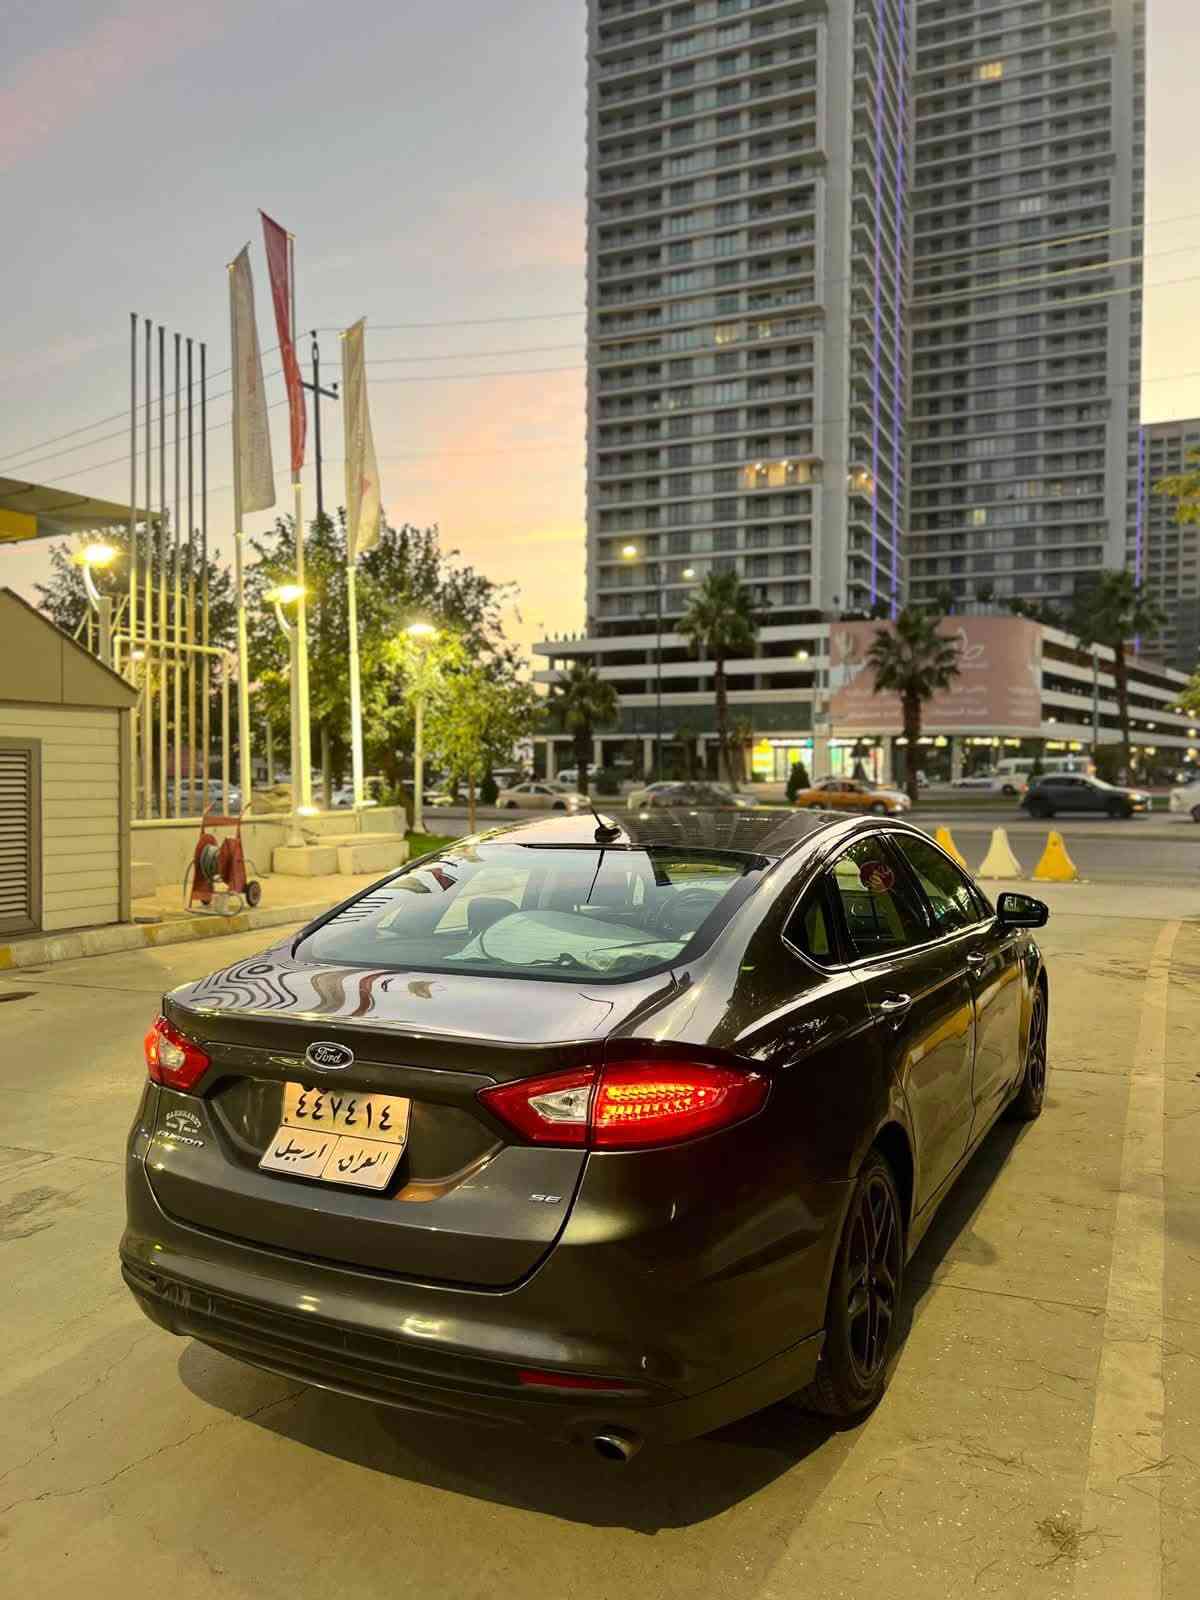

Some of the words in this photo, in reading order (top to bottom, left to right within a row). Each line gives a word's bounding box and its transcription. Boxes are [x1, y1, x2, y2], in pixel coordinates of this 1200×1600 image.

[315, 1047, 342, 1063] Ford
[296, 1093, 393, 1130] ٤٤٧٤١٤
[274, 1139, 328, 1161] اربيل
[338, 1150, 389, 1173] العراق
[530, 1194, 562, 1203] SE
